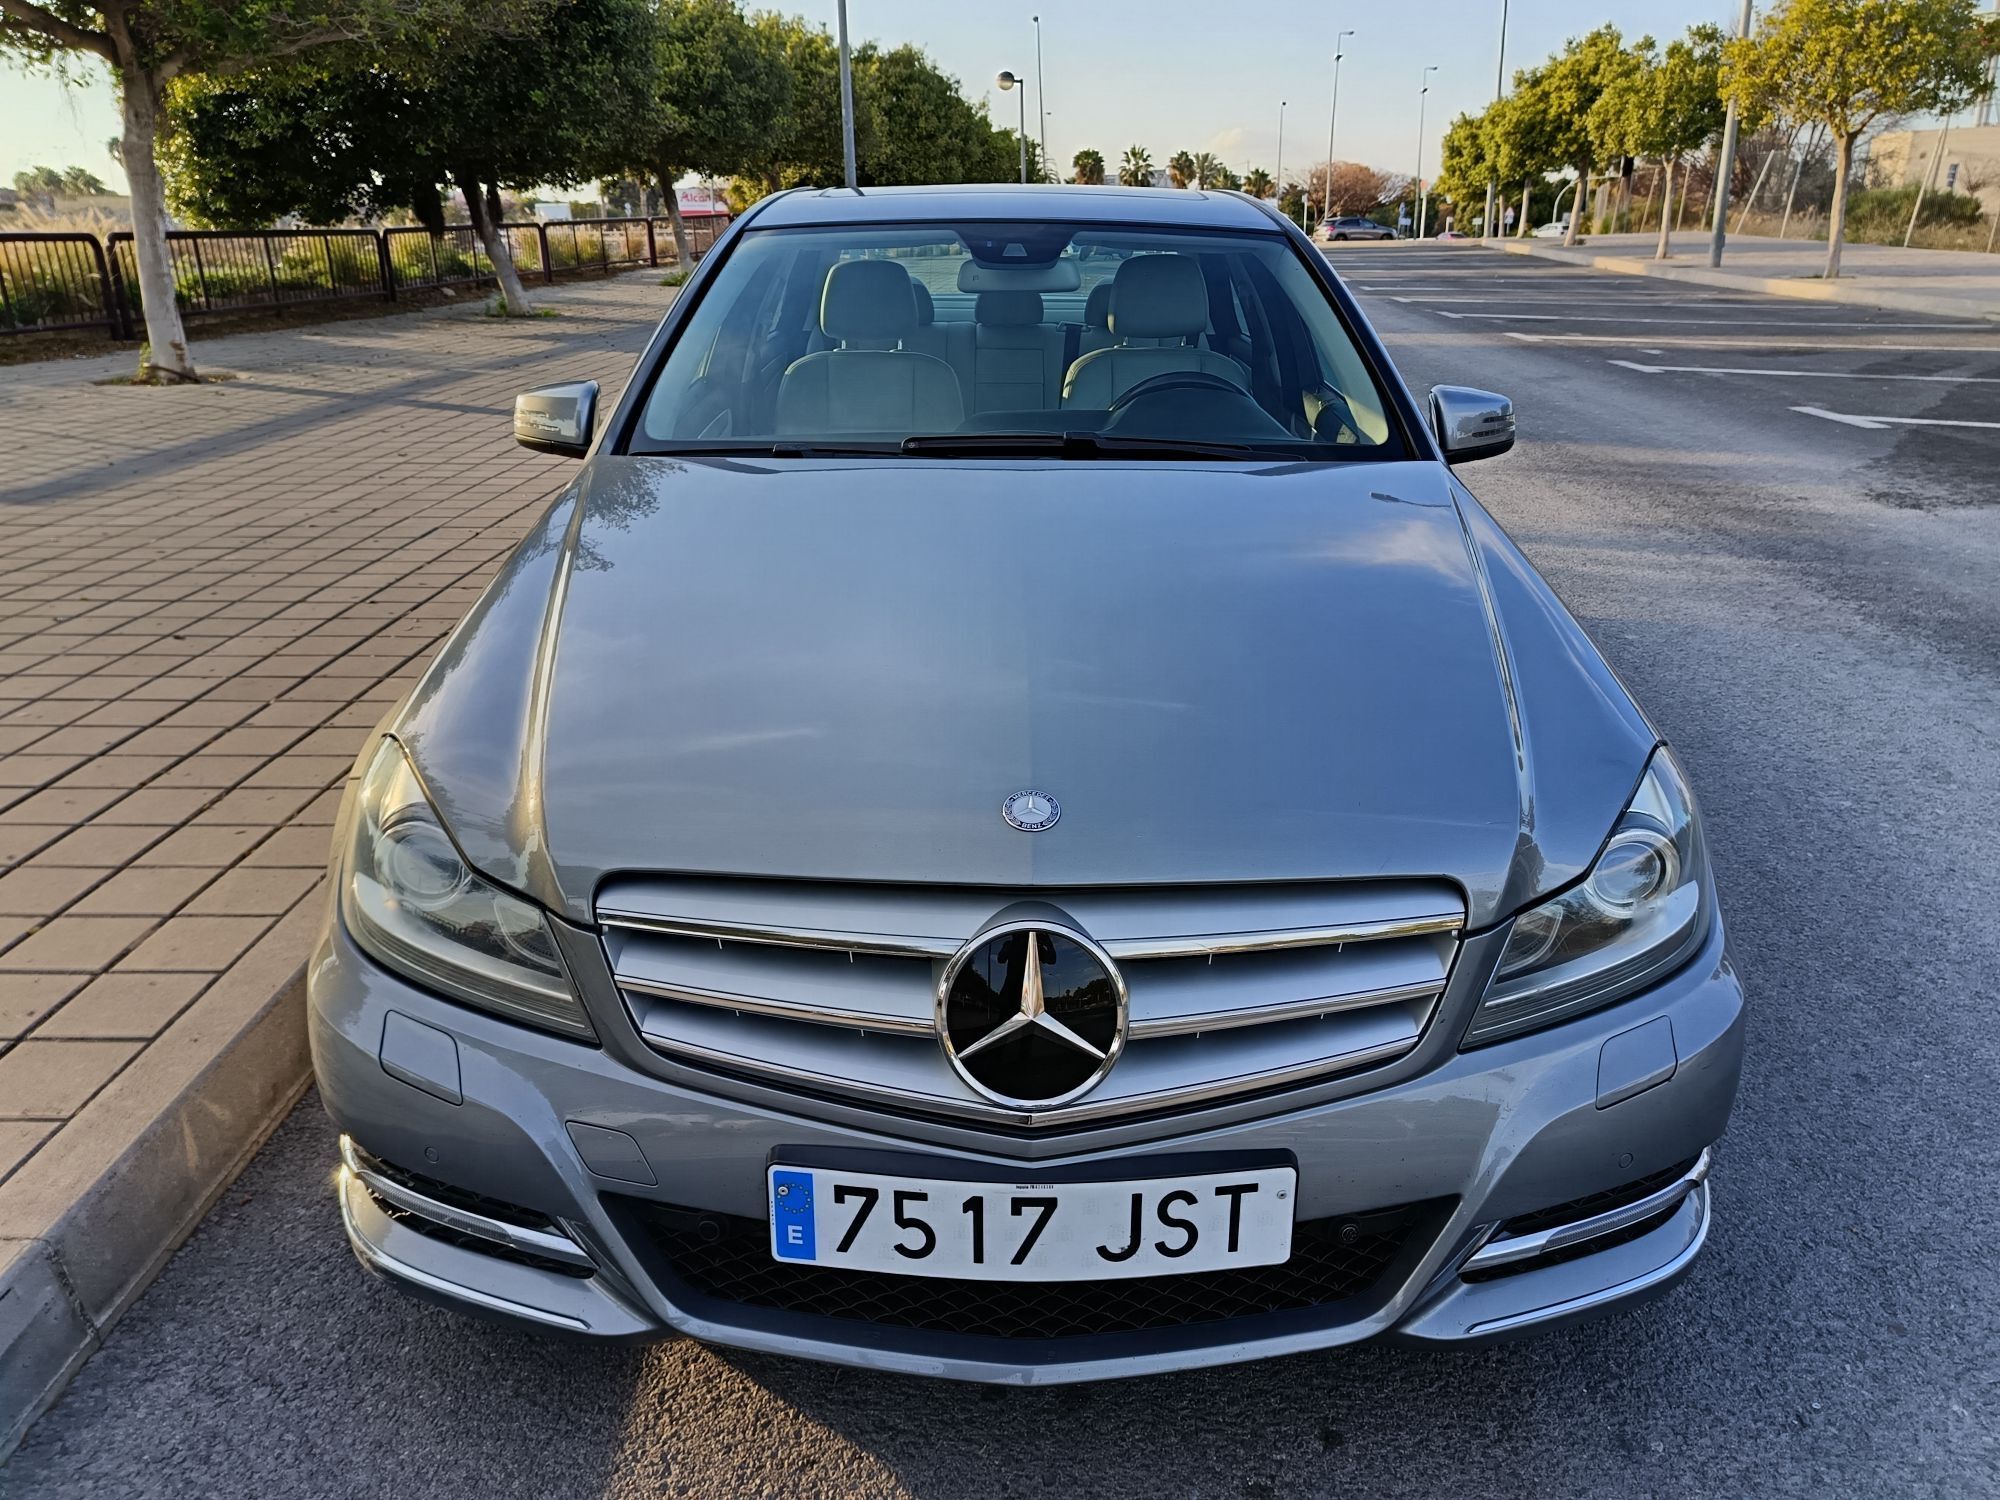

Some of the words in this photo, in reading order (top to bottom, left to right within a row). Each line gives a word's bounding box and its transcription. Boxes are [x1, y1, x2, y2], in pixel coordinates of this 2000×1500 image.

[788, 1225, 803, 1244] E
[833, 1184, 1058, 1265] 7517
[1096, 1183, 1259, 1262] JST
